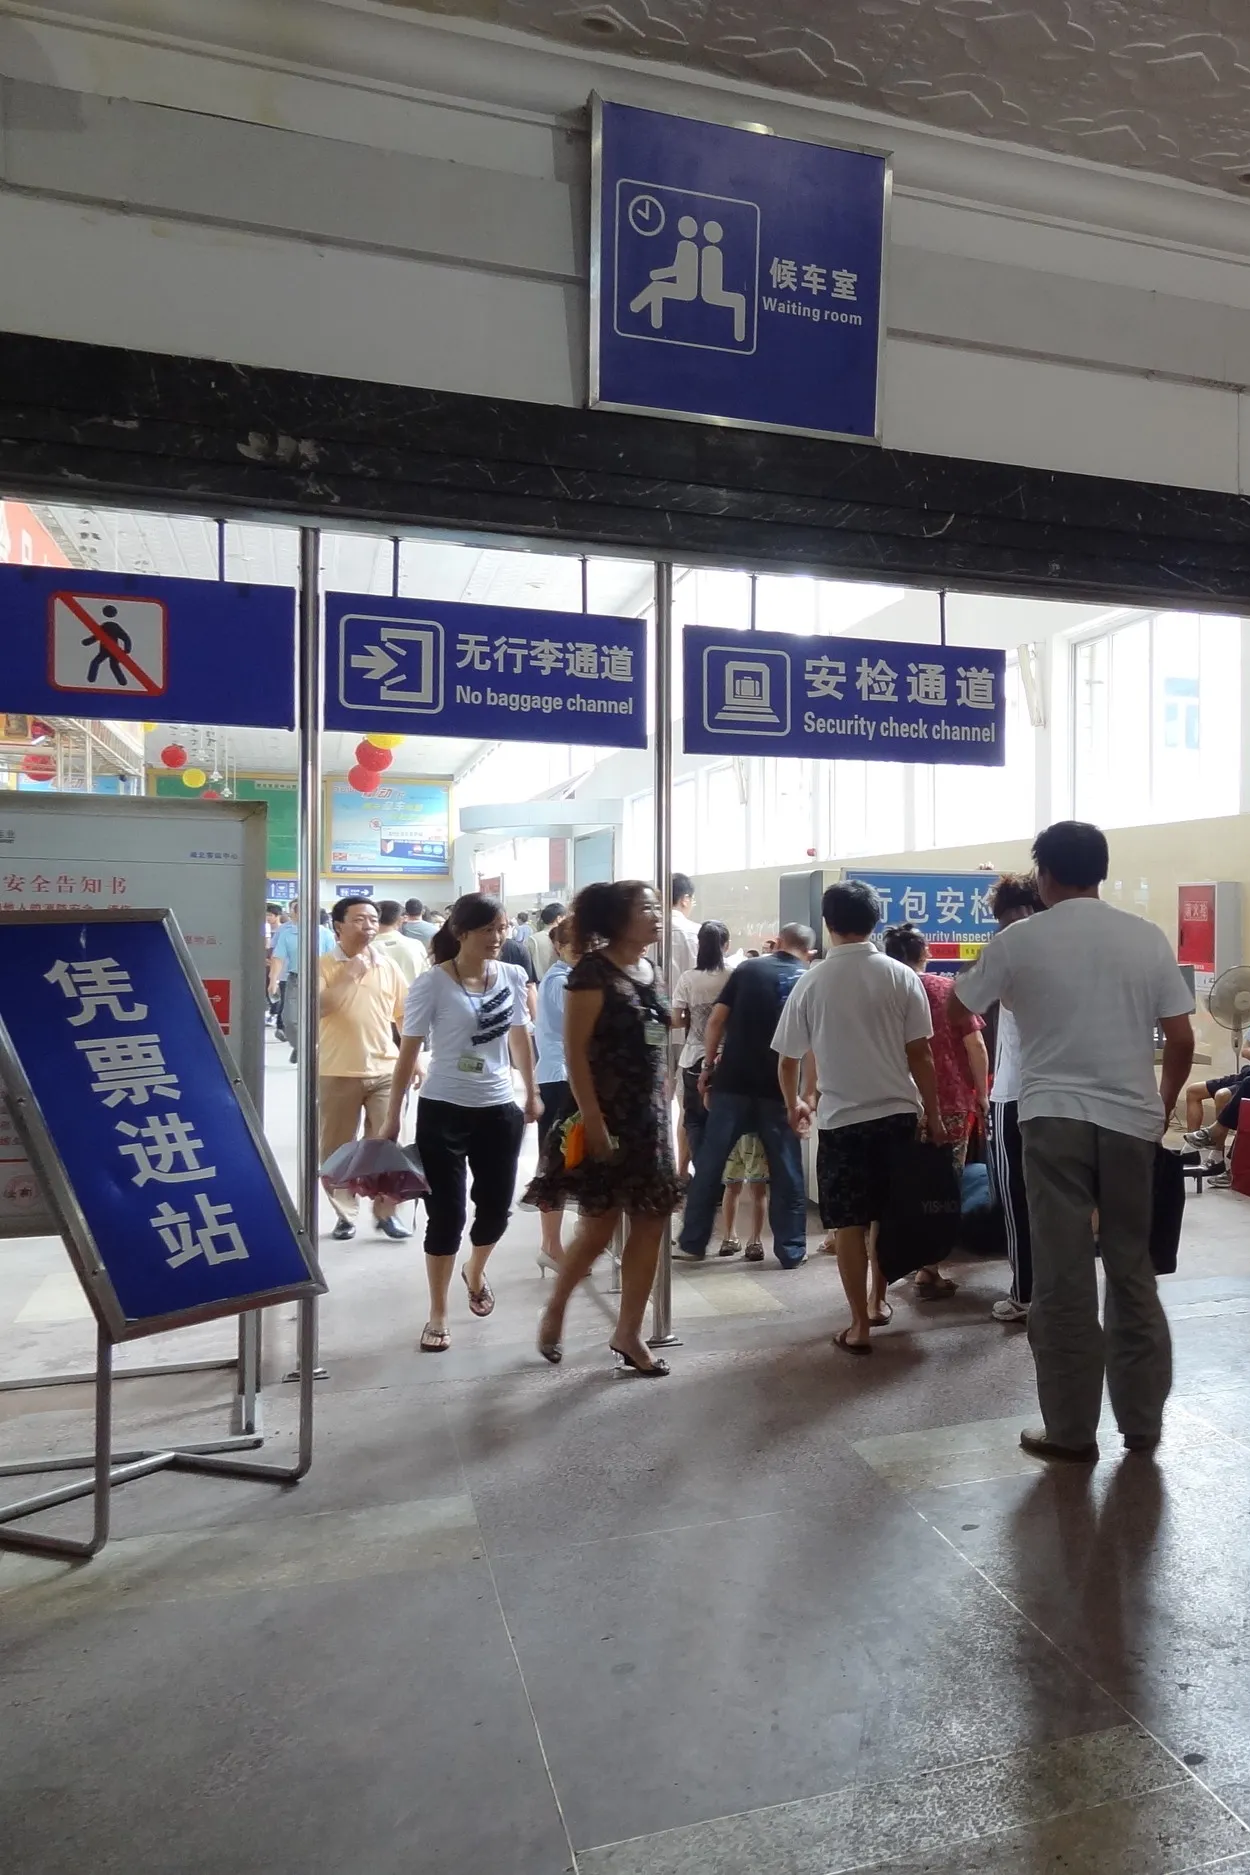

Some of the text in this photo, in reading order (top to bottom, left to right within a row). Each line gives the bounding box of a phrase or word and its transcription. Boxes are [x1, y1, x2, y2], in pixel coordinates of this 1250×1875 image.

[769, 256, 858, 301] 候车室
[762, 296, 863, 326] Waiting room
[456, 633, 634, 682] 无行李通道
[804, 655, 996, 710] 安检通道
[456, 685, 633, 715] No baggage channel
[804, 711, 996, 743] Security check channel
[3, 873, 128, 895] 安全告知书
[952, 930, 995, 943] Inspecti
[43, 957, 250, 1269] 凭票进站
